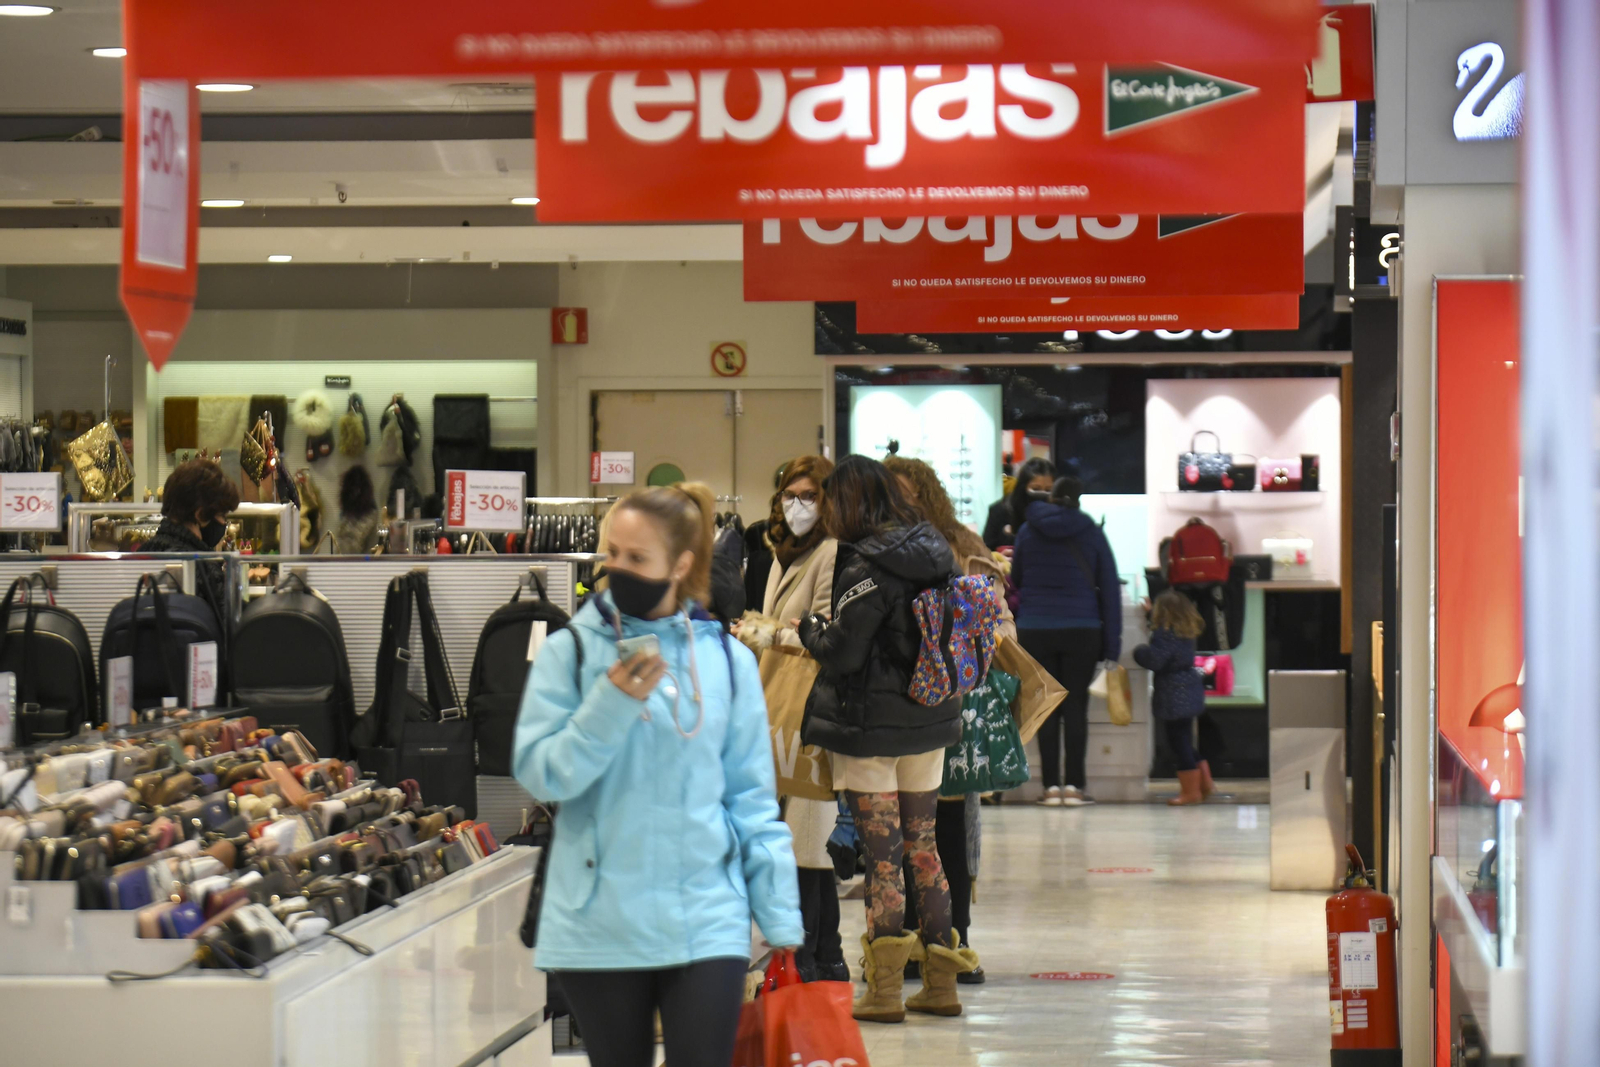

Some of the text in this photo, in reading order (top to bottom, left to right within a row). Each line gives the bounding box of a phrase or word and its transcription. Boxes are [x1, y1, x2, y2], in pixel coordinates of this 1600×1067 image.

[561, 64, 1080, 169] rebajas
[740, 185, 1090, 201] SI NO QUEDA SATISFECHO LE DEVOLVEMOS SU DINERO
[892, 275, 1146, 287] SI NO QUEDA SATISFECHO LE DEVOLVEMOS SU DINERO
[5, 495, 55, 513] -30%
[452, 479, 464, 520] rebajas
[469, 493, 519, 512] -30%
[855, 579, 875, 594] LOVE
